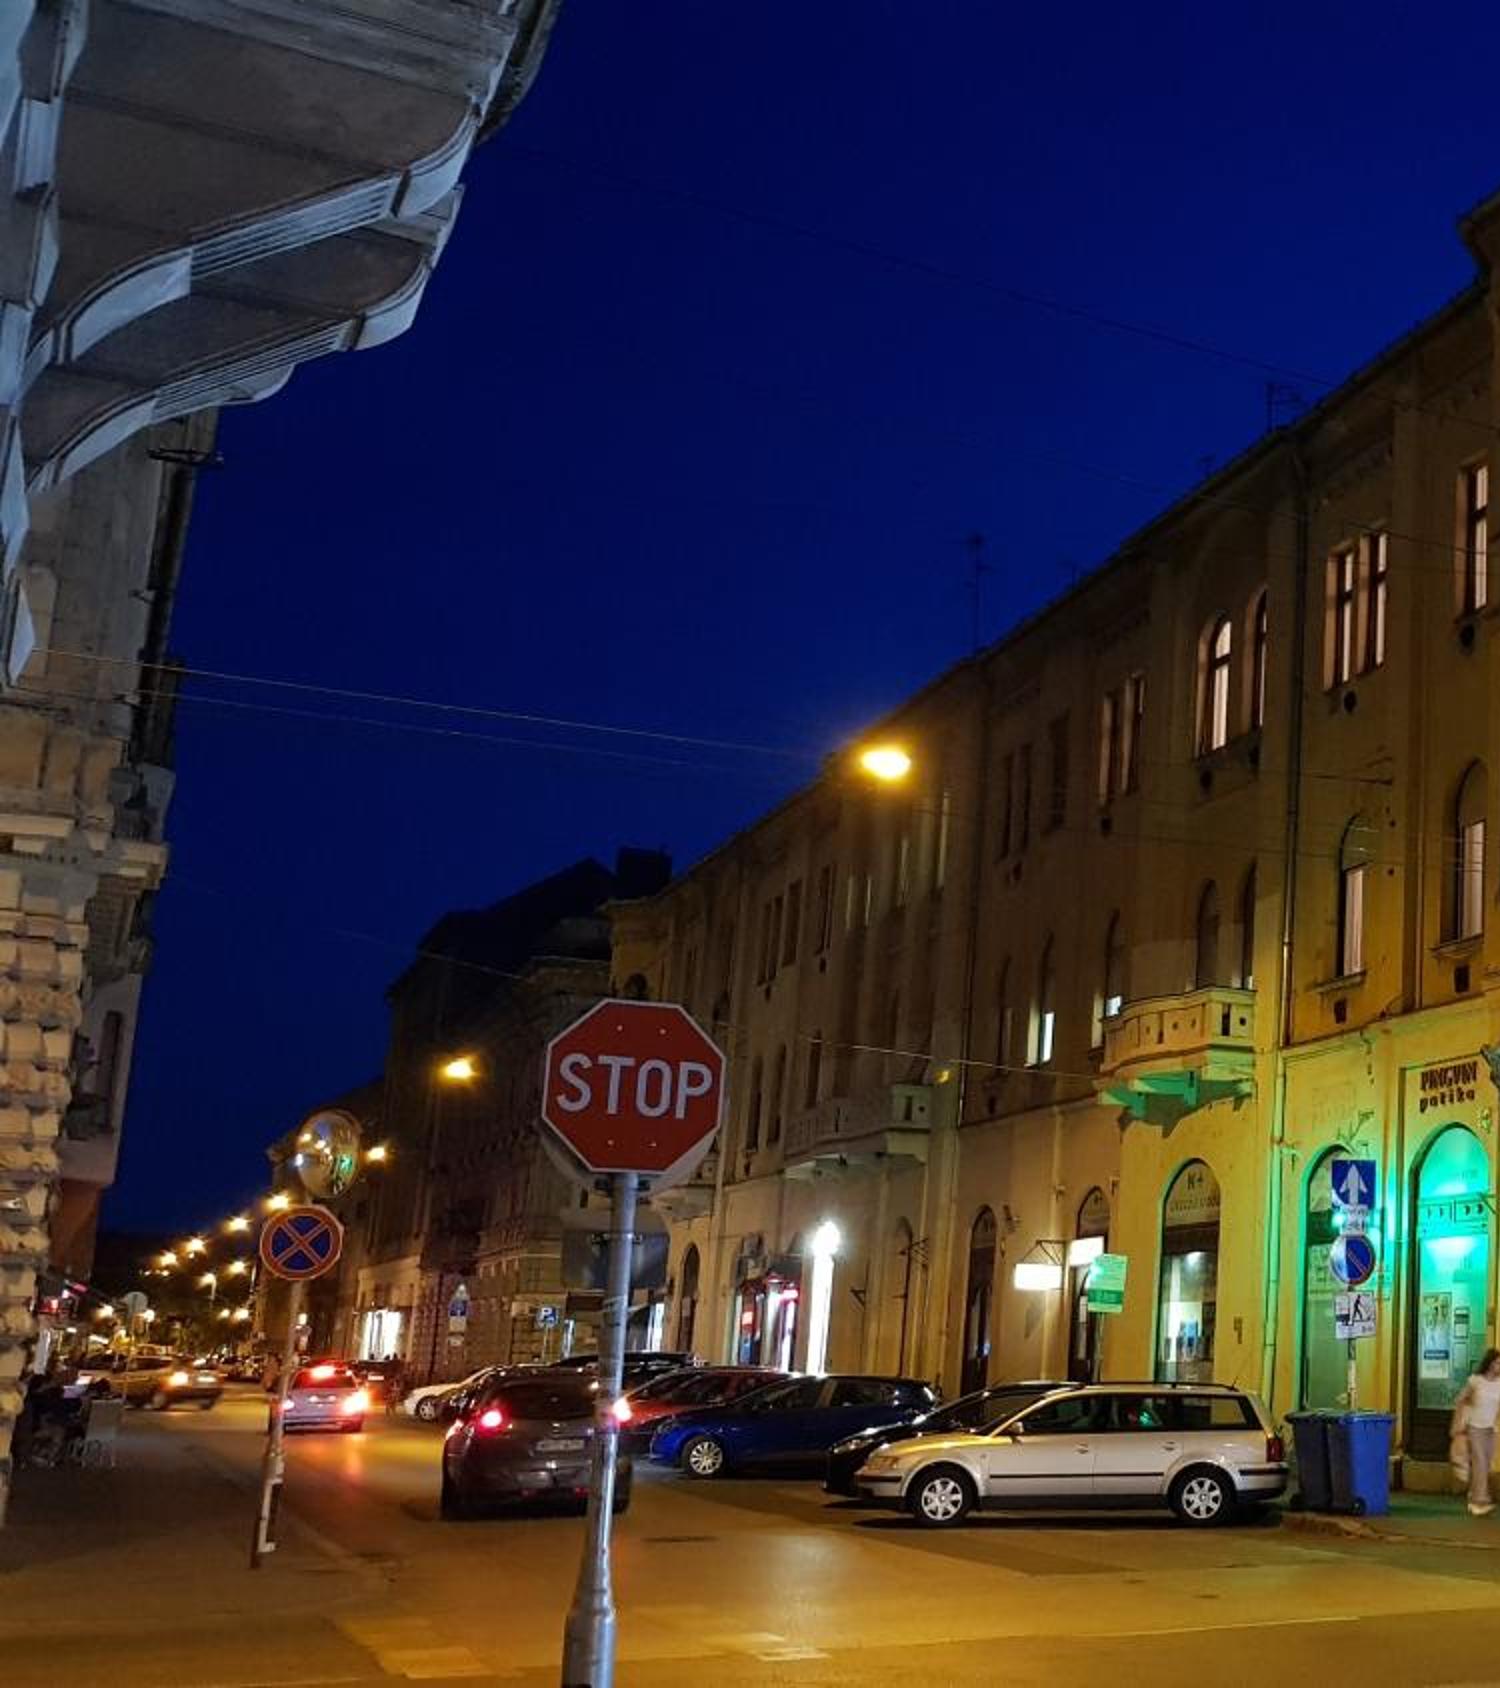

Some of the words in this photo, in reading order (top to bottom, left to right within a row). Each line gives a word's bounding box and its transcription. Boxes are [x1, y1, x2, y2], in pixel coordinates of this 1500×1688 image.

[556, 1052, 713, 1120] STOP
[1420, 1060, 1477, 1092] PINGVIN
[1420, 1086, 1475, 1113] patika
